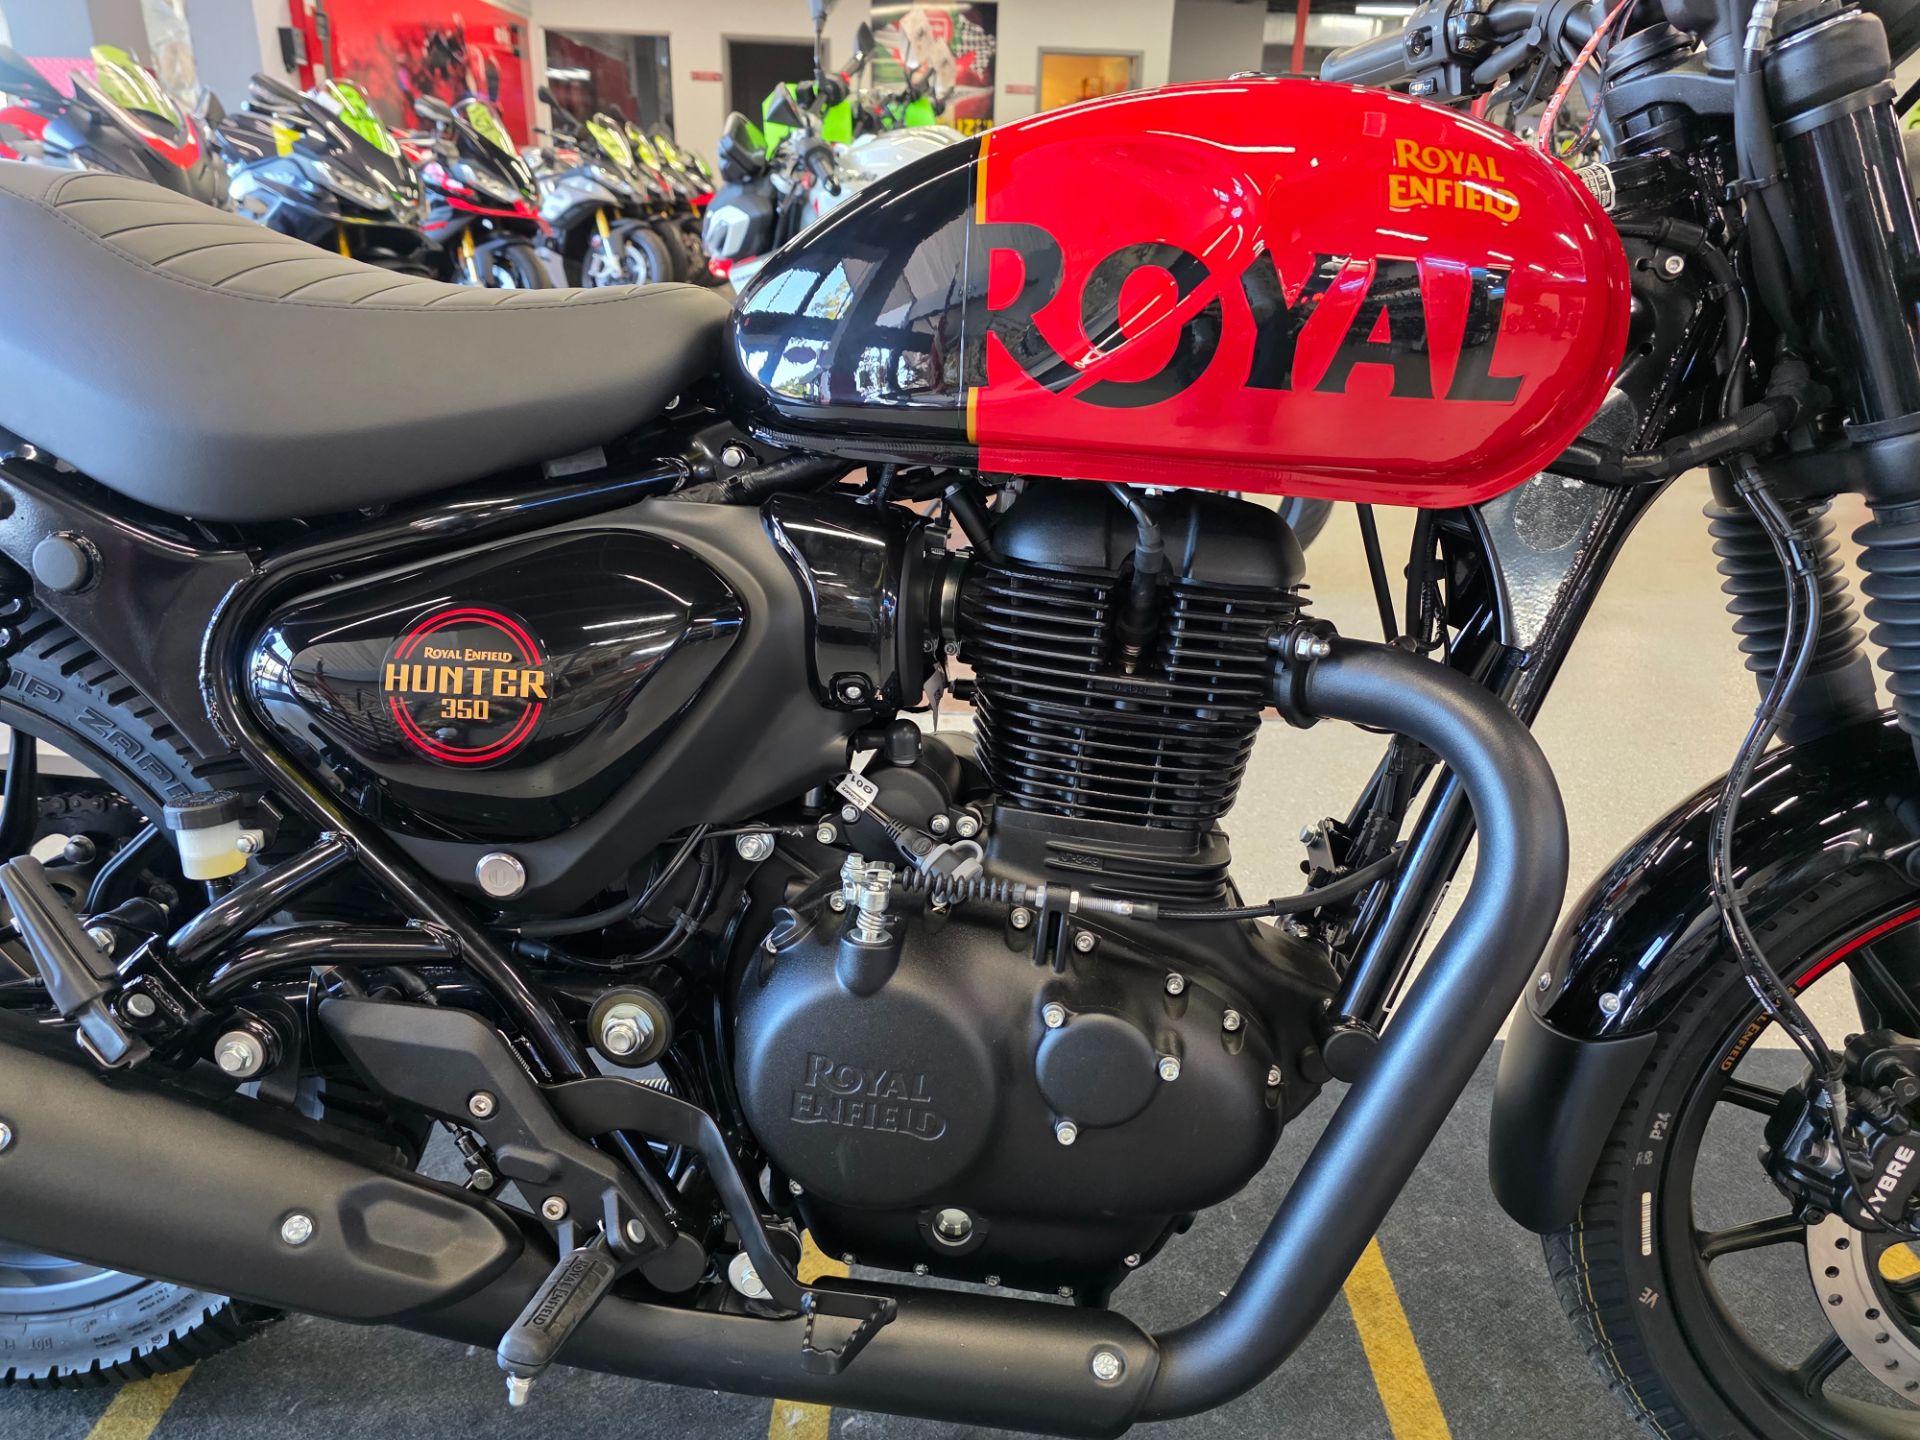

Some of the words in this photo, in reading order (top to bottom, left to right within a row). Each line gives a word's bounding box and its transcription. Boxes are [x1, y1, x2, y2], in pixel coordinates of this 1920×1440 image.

[1395, 138, 1505, 183] ROYAL
[1388, 174, 1521, 223] ENFIELD
[966, 222, 1525, 408] ROYAL
[423, 646, 463, 660] ROYAL
[464, 648, 513, 663] ENFIELD
[385, 663, 548, 699] HUNTER
[440, 698, 490, 720] 350
[1721, 1023, 1761, 1072] ENFIELD
[805, 1052, 931, 1102] ROYAL
[790, 1089, 947, 1141] ENFIELD
[1649, 1112, 1672, 1140] P24
[560, 1259, 590, 1288] ROYAL
[533, 1287, 569, 1326] ENFIELD
